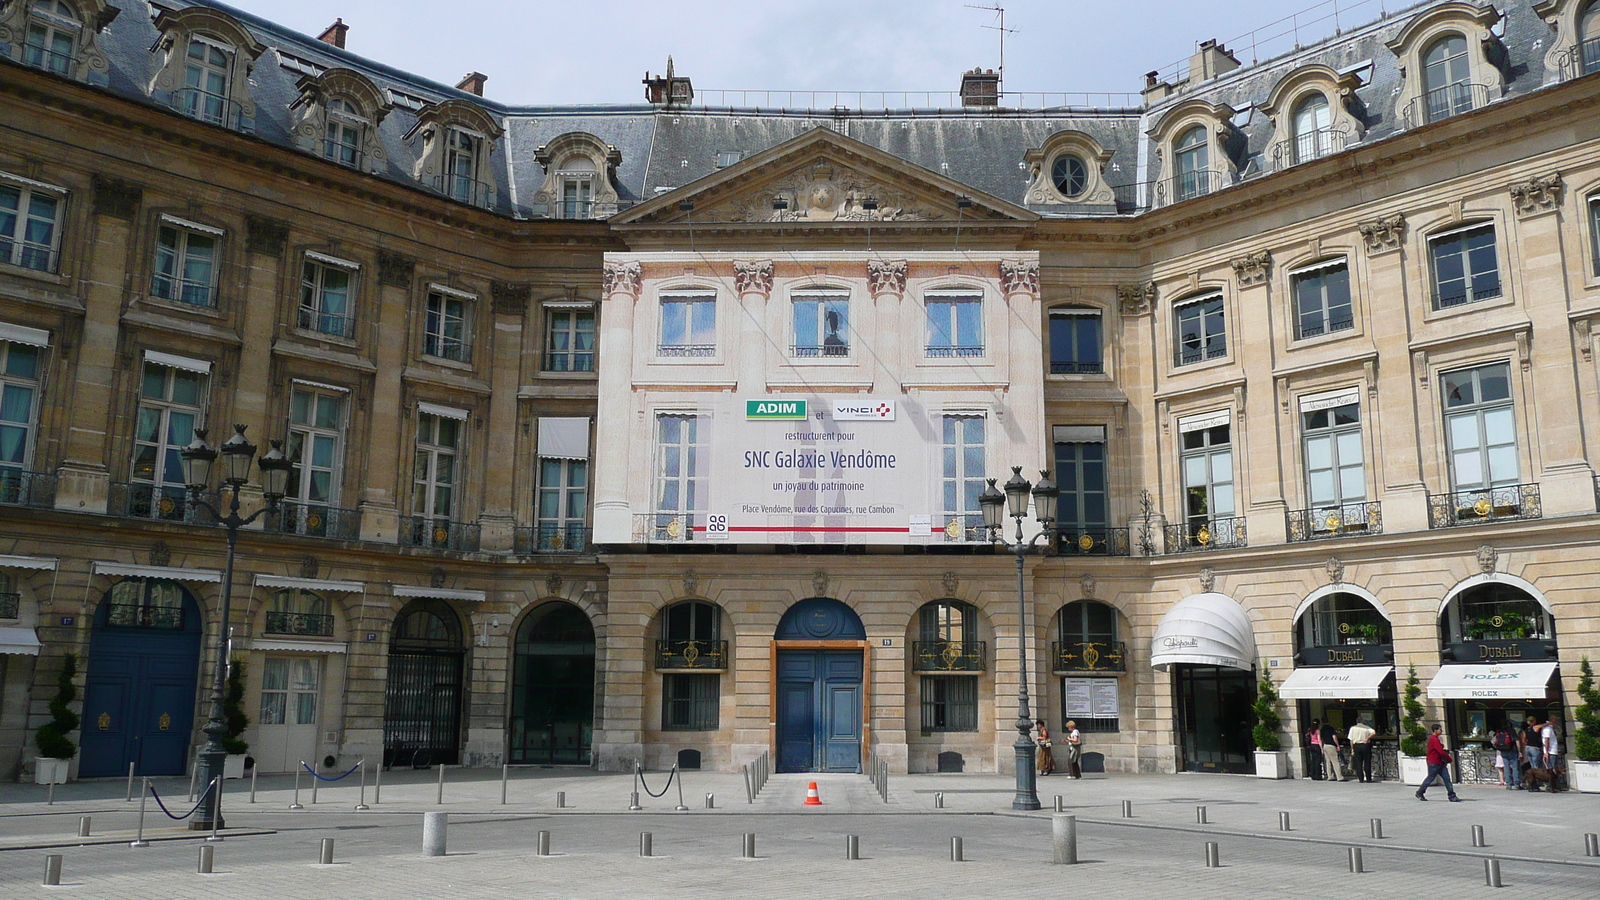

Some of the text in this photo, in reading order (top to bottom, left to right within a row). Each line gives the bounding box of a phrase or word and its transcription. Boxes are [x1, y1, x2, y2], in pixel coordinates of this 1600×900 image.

[756, 403, 797, 414] ADIM
[815, 411, 825, 420] et
[785, 432, 855, 442] restructurent pour
[744, 449, 896, 468] SNC Galaxie Vendôme
[773, 480, 865, 493] un joyau du patrimoine
[742, 504, 760, 513] Place
[807, 505, 819, 513] des
[868, 505, 895, 514] Cambon
